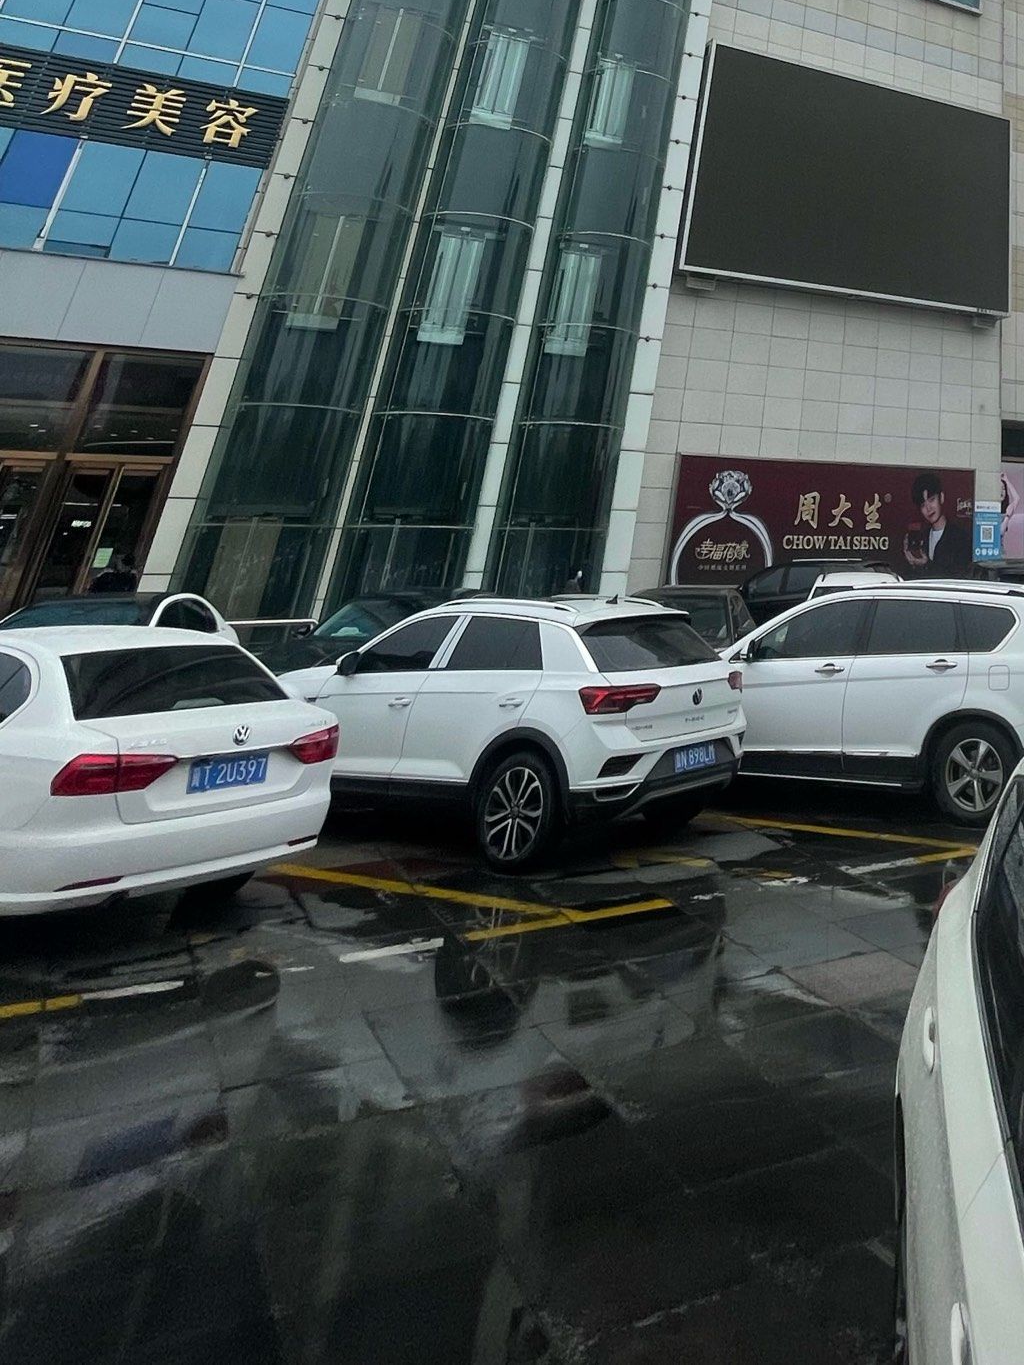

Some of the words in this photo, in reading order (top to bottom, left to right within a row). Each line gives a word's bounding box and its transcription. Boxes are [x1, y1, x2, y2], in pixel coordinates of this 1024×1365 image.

[793, 491, 882, 531] 周大生
[782, 535, 826, 550] CHOW
[828, 536, 851, 550] TAI
[852, 536, 889, 551] SENG
